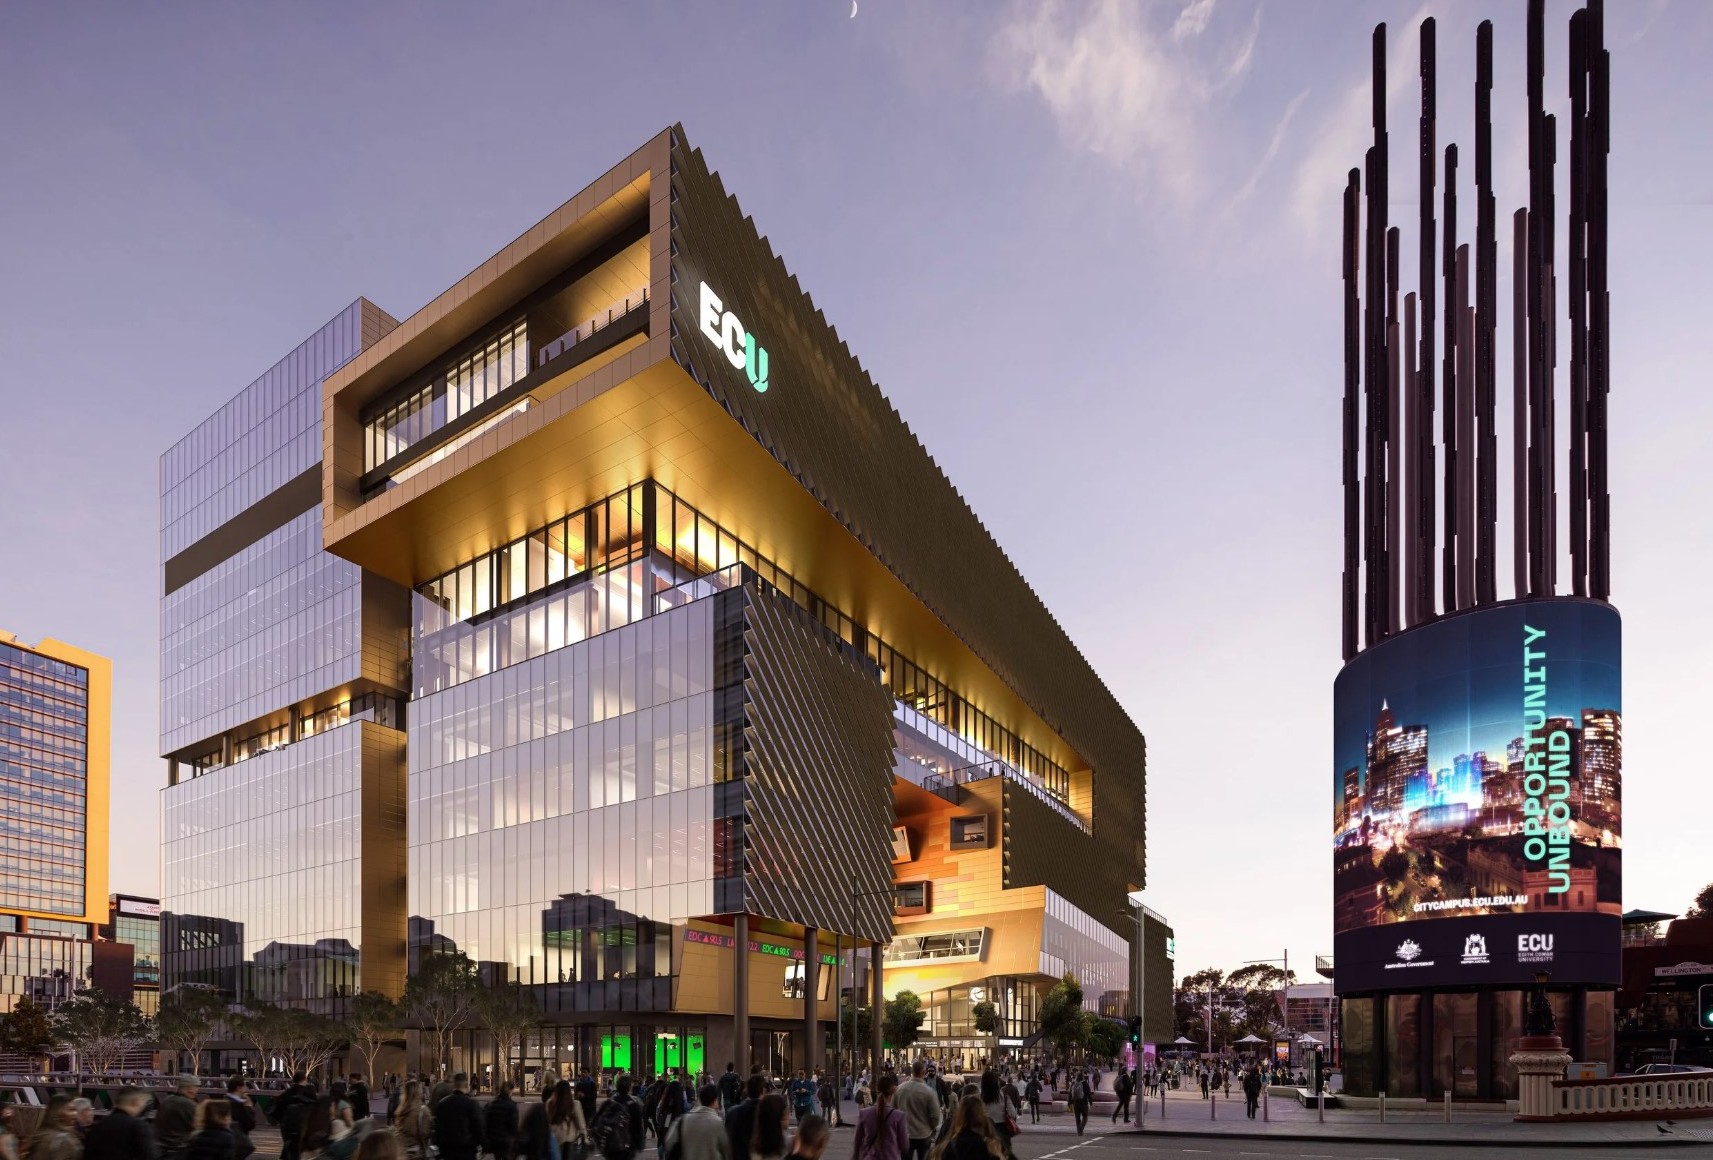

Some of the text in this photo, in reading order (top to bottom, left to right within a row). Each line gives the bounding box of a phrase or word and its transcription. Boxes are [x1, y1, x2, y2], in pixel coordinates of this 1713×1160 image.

[700, 281, 768, 393] ECU
[1523, 624, 1546, 861] OPPORTUNITY
[1548, 730, 1571, 893] UNBOUND
[1413, 895, 1529, 912] CITYCAMPUS.ECU.EDU.AU
[688, 931, 702, 942] EDC
[762, 944, 774, 954] EDC
[1518, 933, 1554, 951] ECU
[1407, 960, 1434, 968] Government
[1661, 967, 1702, 975] WELLINGTON
